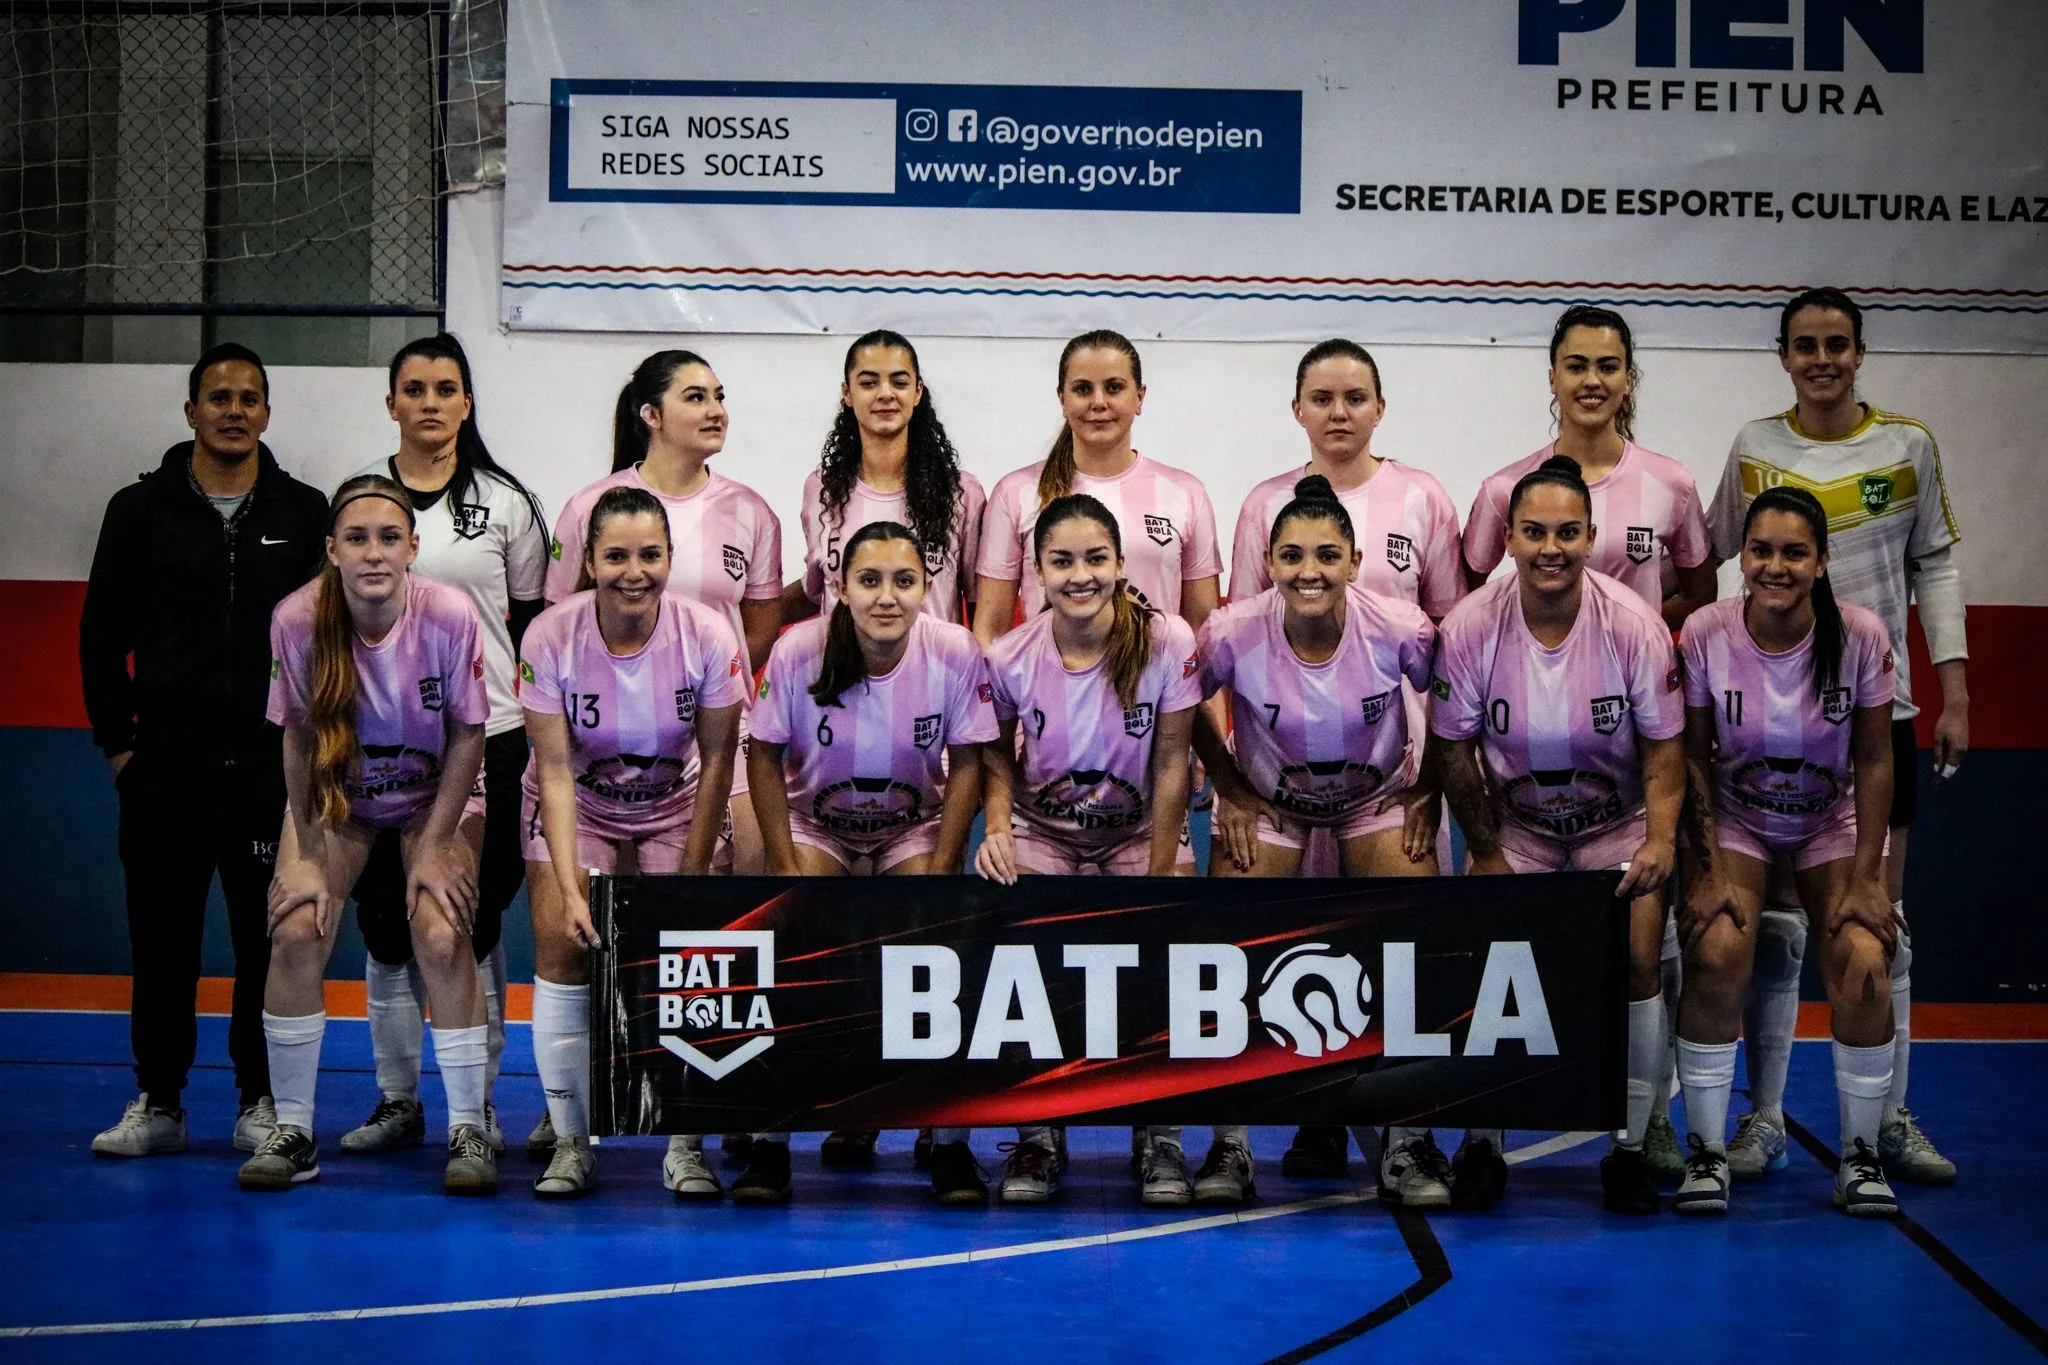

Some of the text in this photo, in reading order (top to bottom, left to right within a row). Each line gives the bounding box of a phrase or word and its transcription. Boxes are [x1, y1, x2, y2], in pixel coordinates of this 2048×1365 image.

[1557, 78, 1885, 116] PREFEITURA
[601, 114, 790, 140] SIGA NOSSAS
[986, 116, 1263, 154] @governodepien
[601, 152, 824, 178] REDES SOCIAIS
[905, 157, 1182, 192] www.pien.gov.br
[1335, 183, 1554, 214] SECRETARIA
[1561, 187, 1607, 215] DE
[1616, 188, 1784, 224] ESPORTE,
[1791, 191, 1951, 221] CULTURA
[1960, 195, 1980, 221] E
[1387, 538, 1405, 551] BAT
[1627, 532, 1645, 542] BAT
[827, 537, 840, 572] 5
[1387, 550, 1411, 563] BOLA
[1626, 542, 1653, 554] BOLA
[926, 554, 944, 566] OLA
[419, 682, 438, 696] BAT
[421, 692, 442, 705] BOL
[675, 693, 693, 706] BAT
[1591, 702, 1613, 716] BAT
[1724, 689, 1743, 727] 11
[570, 692, 600, 729] 13
[1123, 708, 1143, 721] BAT
[1263, 703, 1280, 731] 7
[816, 714, 833, 747] 6
[914, 720, 933, 733] BAT
[1125, 717, 1152, 731] BOLA
[914, 728, 939, 743] BOLA
[658, 953, 736, 989] BAT
[658, 994, 775, 1030] BOLA
